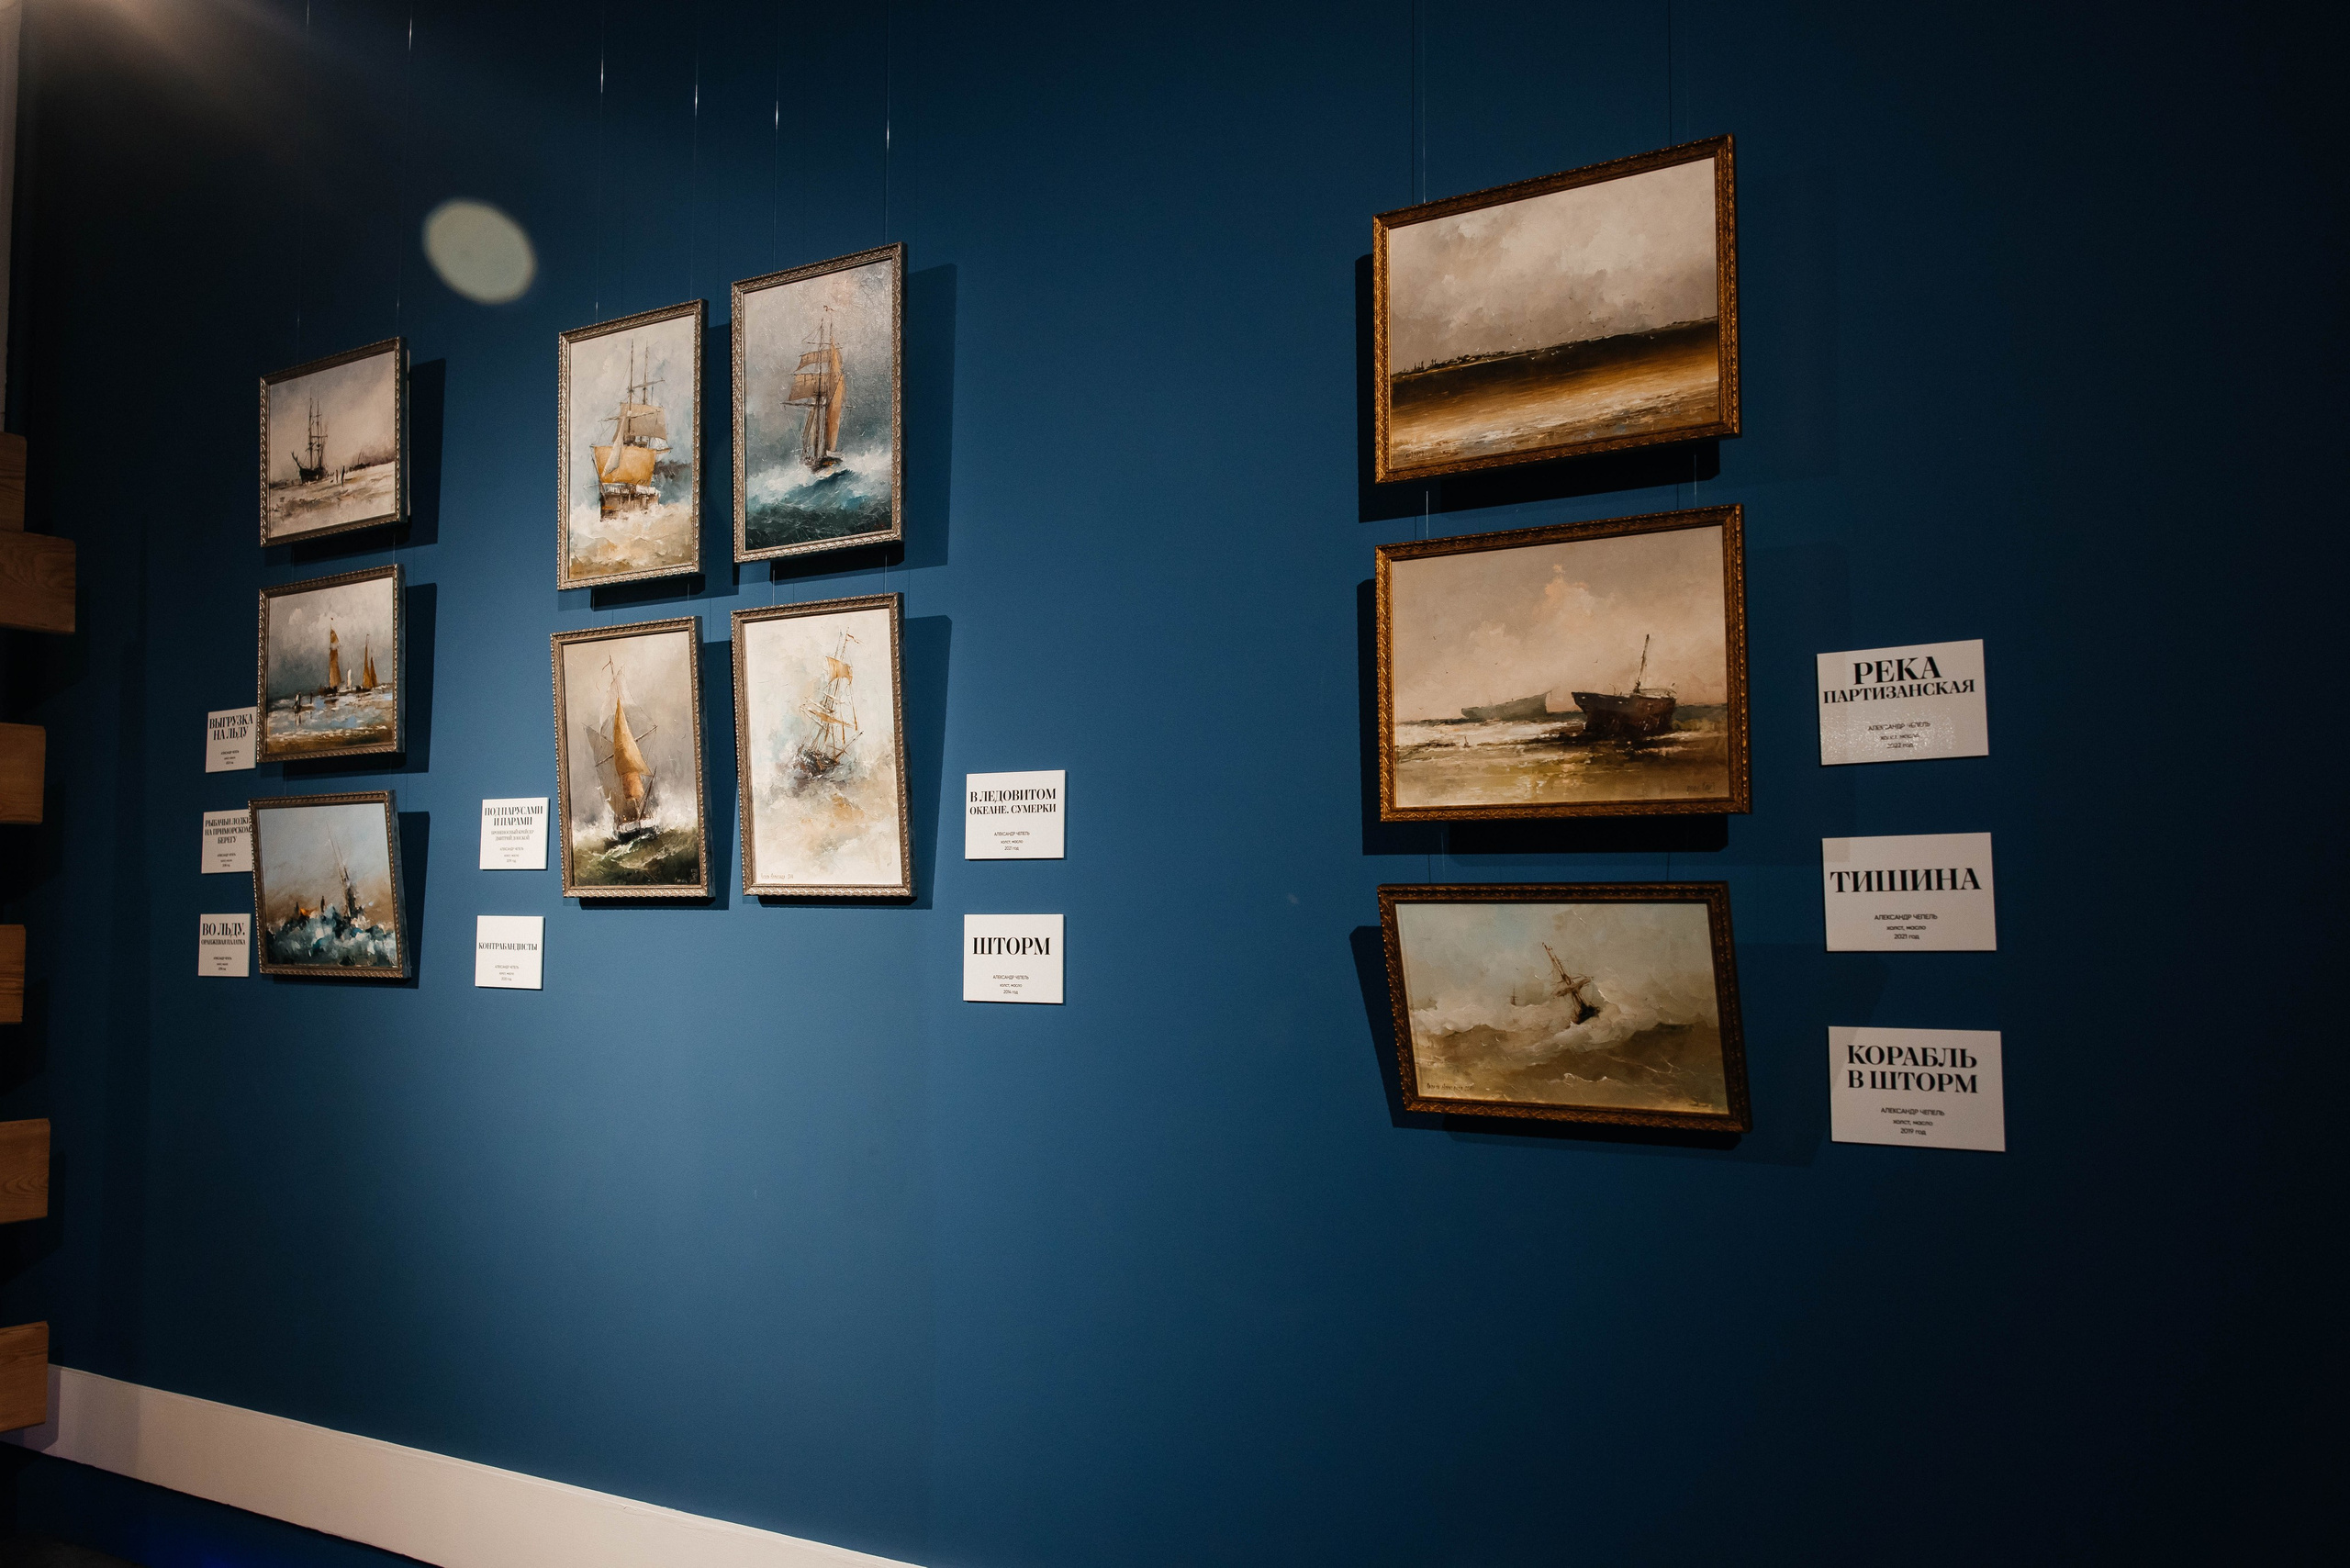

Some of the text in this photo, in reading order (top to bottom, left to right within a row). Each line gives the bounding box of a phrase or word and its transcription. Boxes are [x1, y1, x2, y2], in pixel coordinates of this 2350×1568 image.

[1854, 656, 1942, 685] РЕКА
[1823, 679, 1975, 703] ПАРТИЗАНСКАЯ
[209, 714, 253, 729] ВЫГРУЗКА
[214, 726, 248, 740] НА ЛЬДУ
[970, 788, 1056, 803] В ЛЕДОВИТОМ
[485, 806, 543, 816] ПОД ПАРУСАМИ
[970, 804, 1056, 815] ОКЕАНЕ. СУМЕРКИ
[501, 817, 532, 825] ПАРАМИ
[1830, 868, 1982, 893] ТИШИНА
[203, 923, 245, 937] ВО ЛЬДУ.
[479, 942, 537, 951] КОНТРАБАНДИСТЫ
[973, 937, 1050, 955] ШТОРМ
[1847, 1045, 1977, 1068] КОРАБЛЬ
[1848, 1070, 1978, 1093] В ШТОРМ
